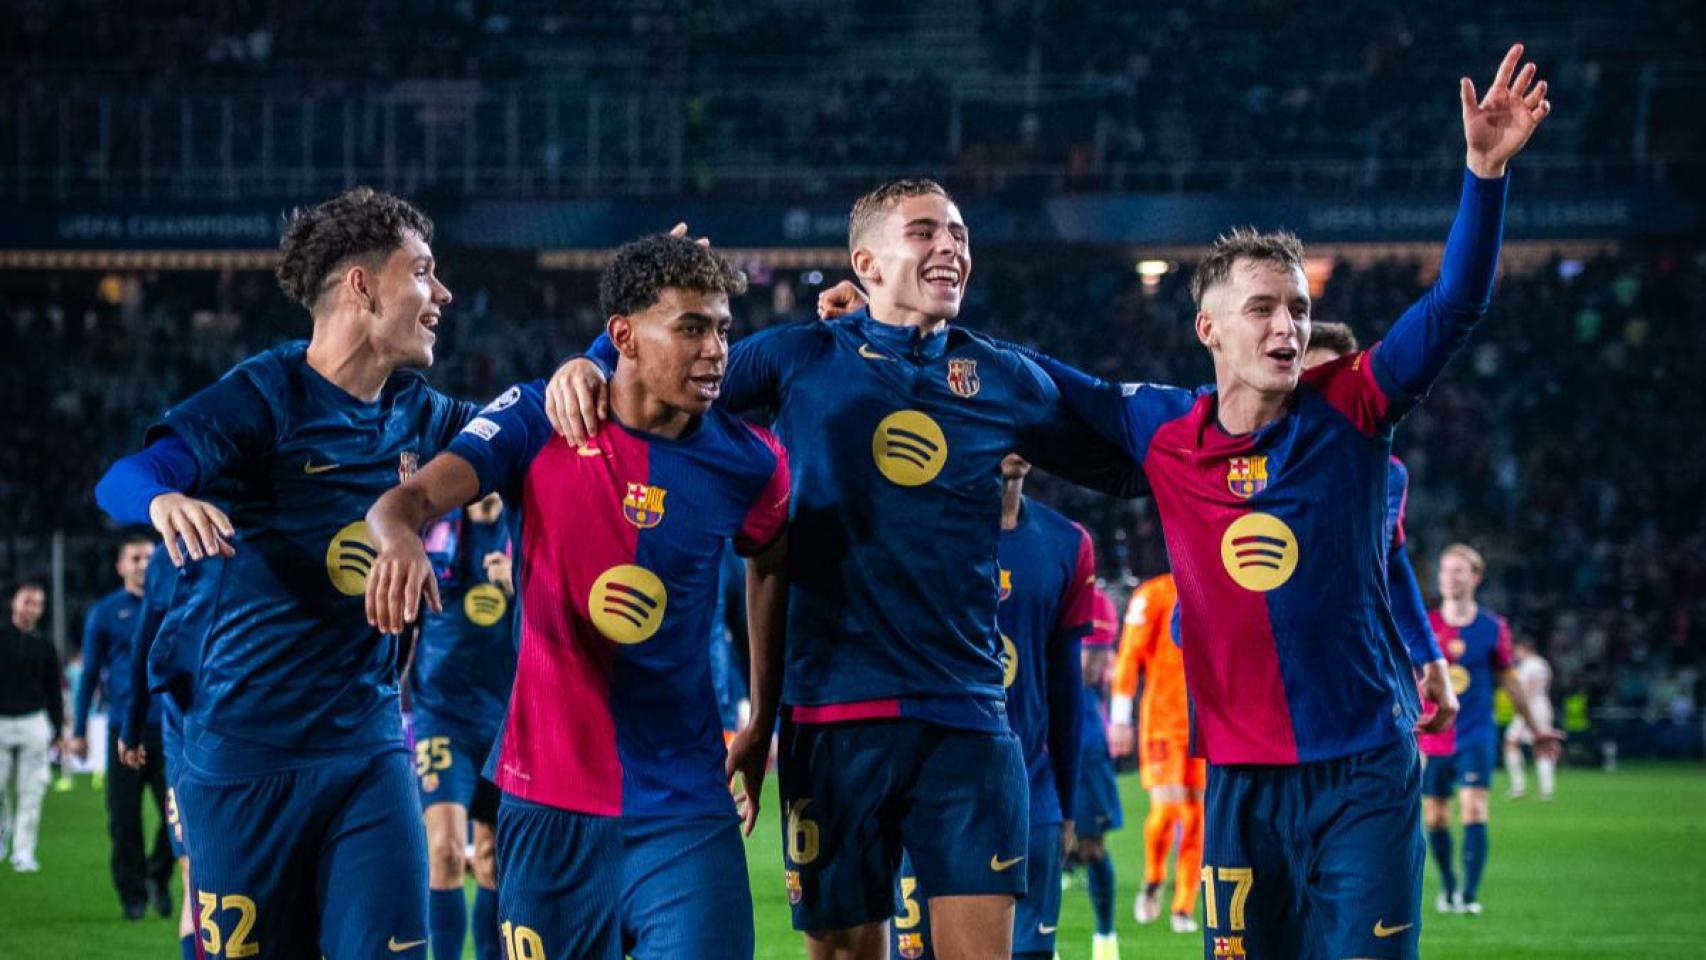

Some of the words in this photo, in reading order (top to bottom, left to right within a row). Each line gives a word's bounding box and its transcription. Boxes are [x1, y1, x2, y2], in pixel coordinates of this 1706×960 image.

[416, 736, 452, 775] 35
[198, 890, 259, 958] 32
[895, 877, 921, 929] 3
[1201, 865, 1253, 930] 17
